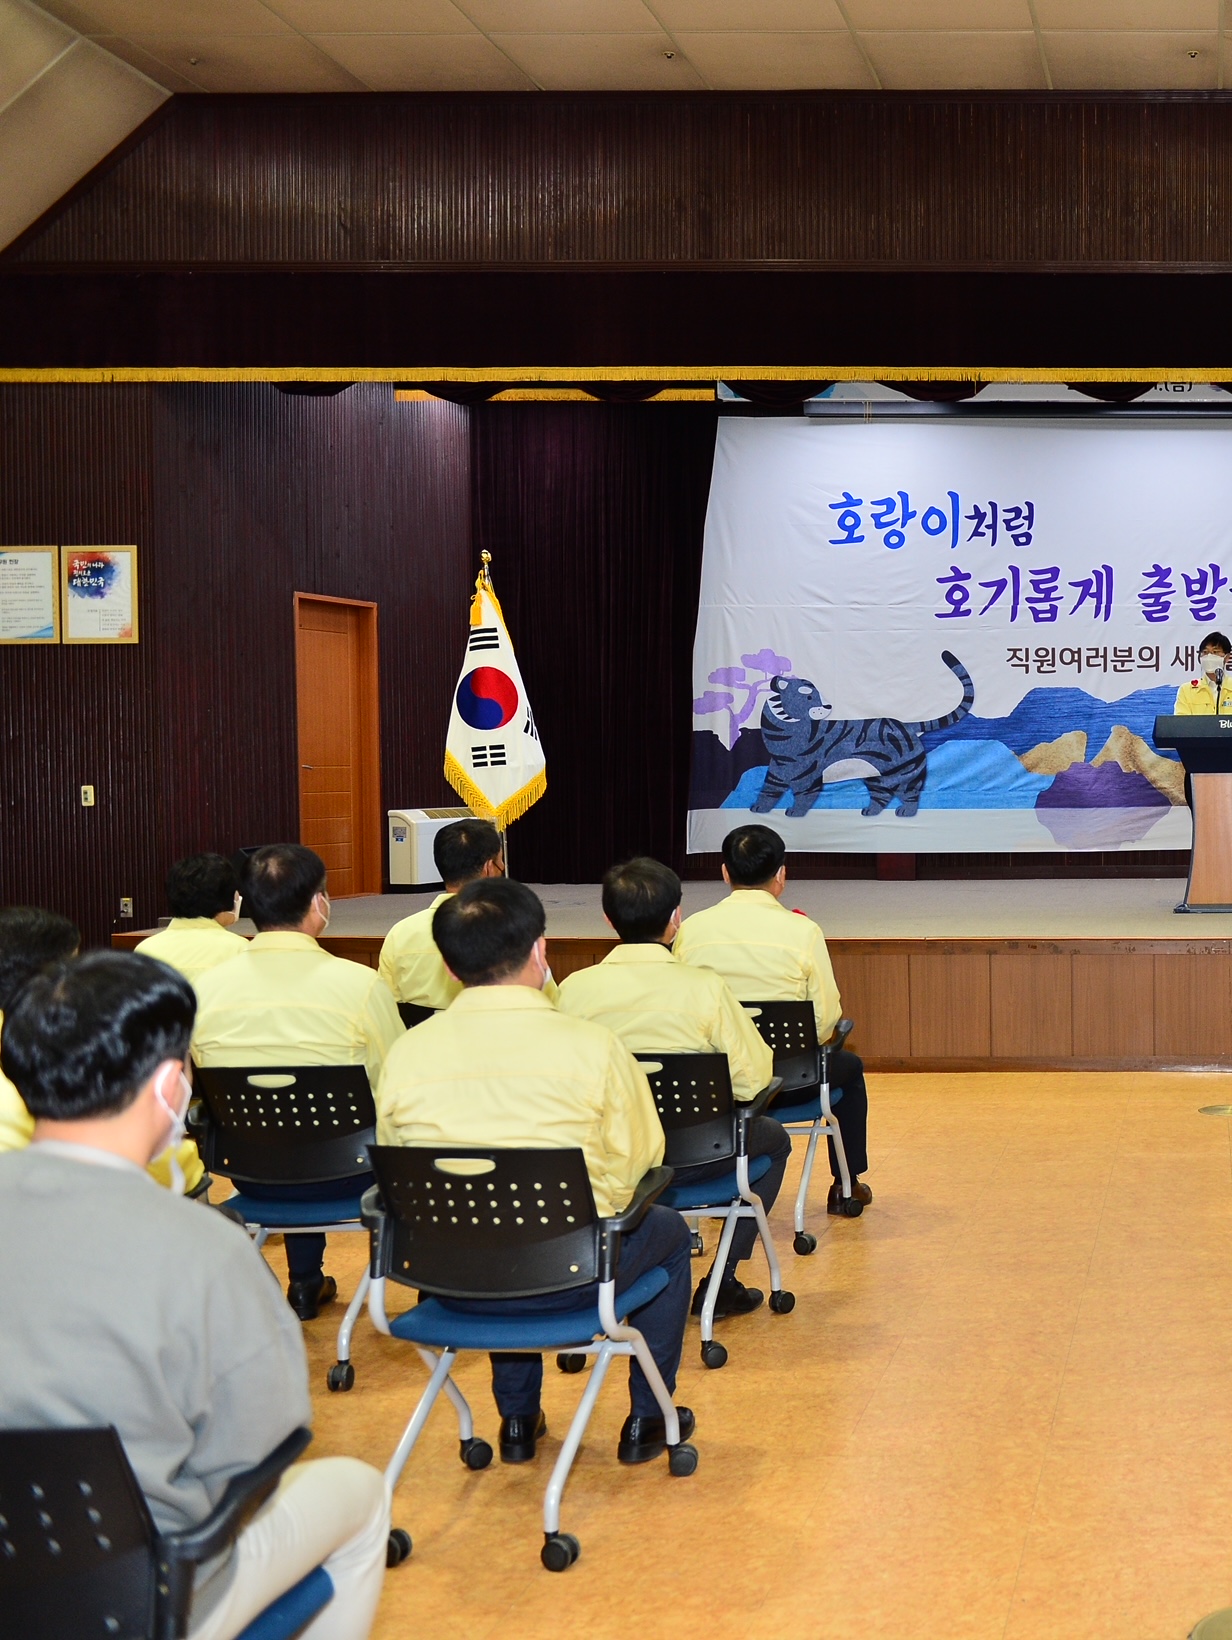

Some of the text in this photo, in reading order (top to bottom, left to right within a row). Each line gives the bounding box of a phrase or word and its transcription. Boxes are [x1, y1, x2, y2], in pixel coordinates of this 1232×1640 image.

[829, 491, 1035, 549] 호랑이처럼
[72, 576, 105, 588] 대한민국
[934, 564, 1114, 623] 호기롭게
[1006, 646, 1160, 673] 직원여러분의
